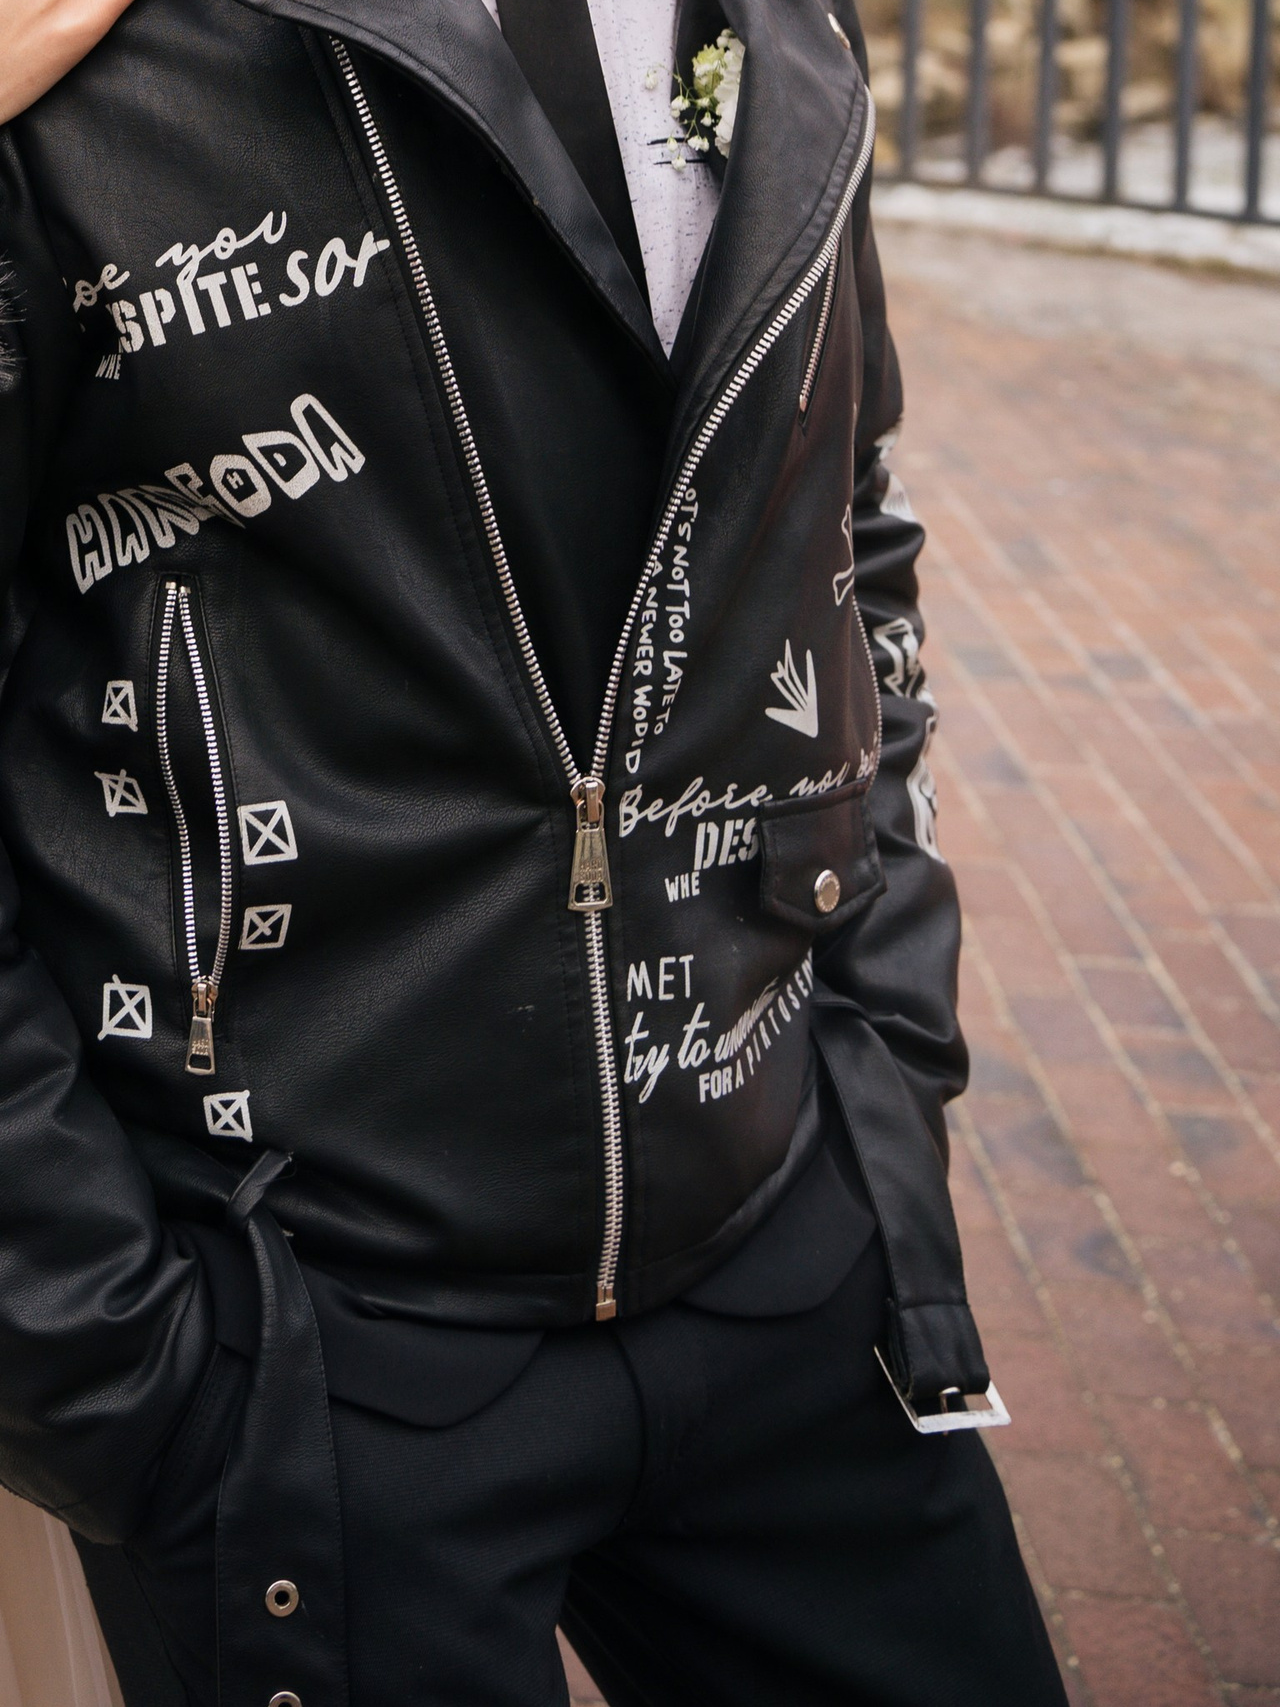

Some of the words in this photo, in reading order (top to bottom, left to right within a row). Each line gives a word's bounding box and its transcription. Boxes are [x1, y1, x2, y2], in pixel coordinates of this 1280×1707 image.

[106, 262, 272, 354] SPITE
[666, 545, 690, 598] NOT
[632, 586, 659, 677] NEWER
[665, 600, 691, 643] TOO
[662, 650, 688, 707] LATE
[653, 707, 671, 736] TO
[618, 775, 774, 838] Before
[664, 871, 700, 903] WHE
[627, 954, 695, 1002] MET
[624, 1011, 670, 1105] try
[677, 1001, 712, 1070] to
[698, 1065, 734, 1104] FOR
